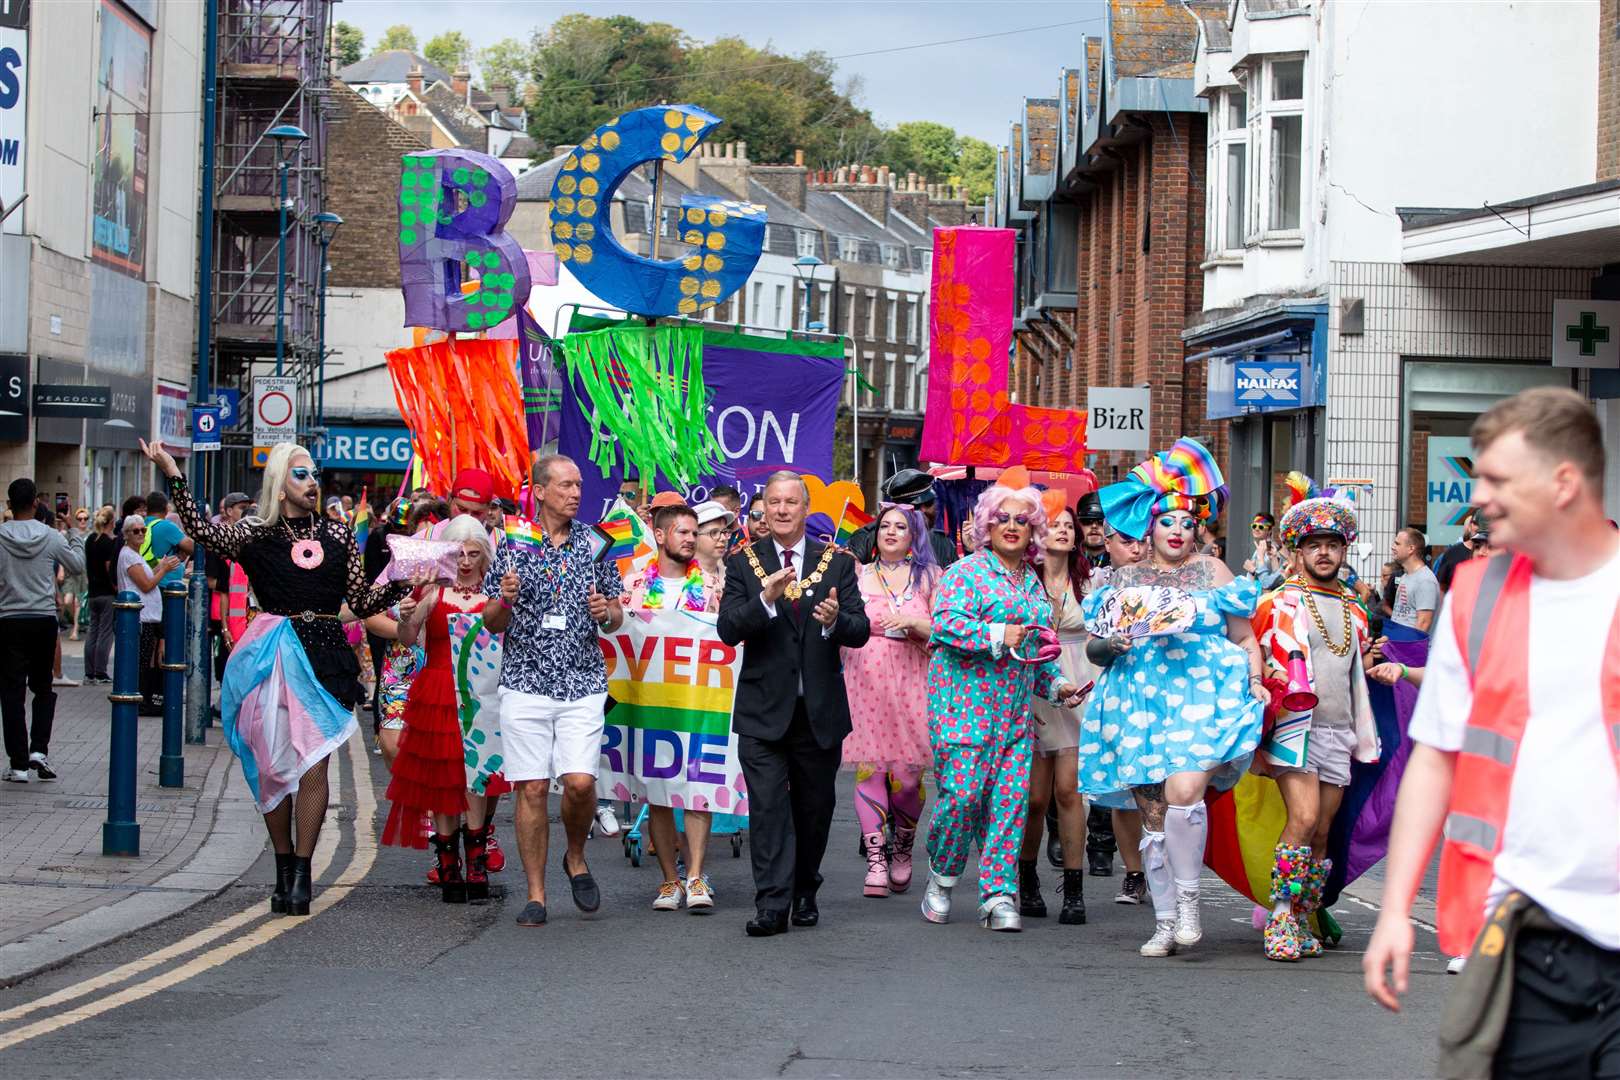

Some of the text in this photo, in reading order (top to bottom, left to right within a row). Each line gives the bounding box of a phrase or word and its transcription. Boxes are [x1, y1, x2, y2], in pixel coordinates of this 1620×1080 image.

[0, 138, 19, 165] M
[1237, 378, 1299, 390] HALIFAX
[37, 395, 107, 403] PEACOCKS
[1093, 407, 1144, 430] BizR
[256, 433, 280, 441] Except
[328, 436, 410, 461] REGG
